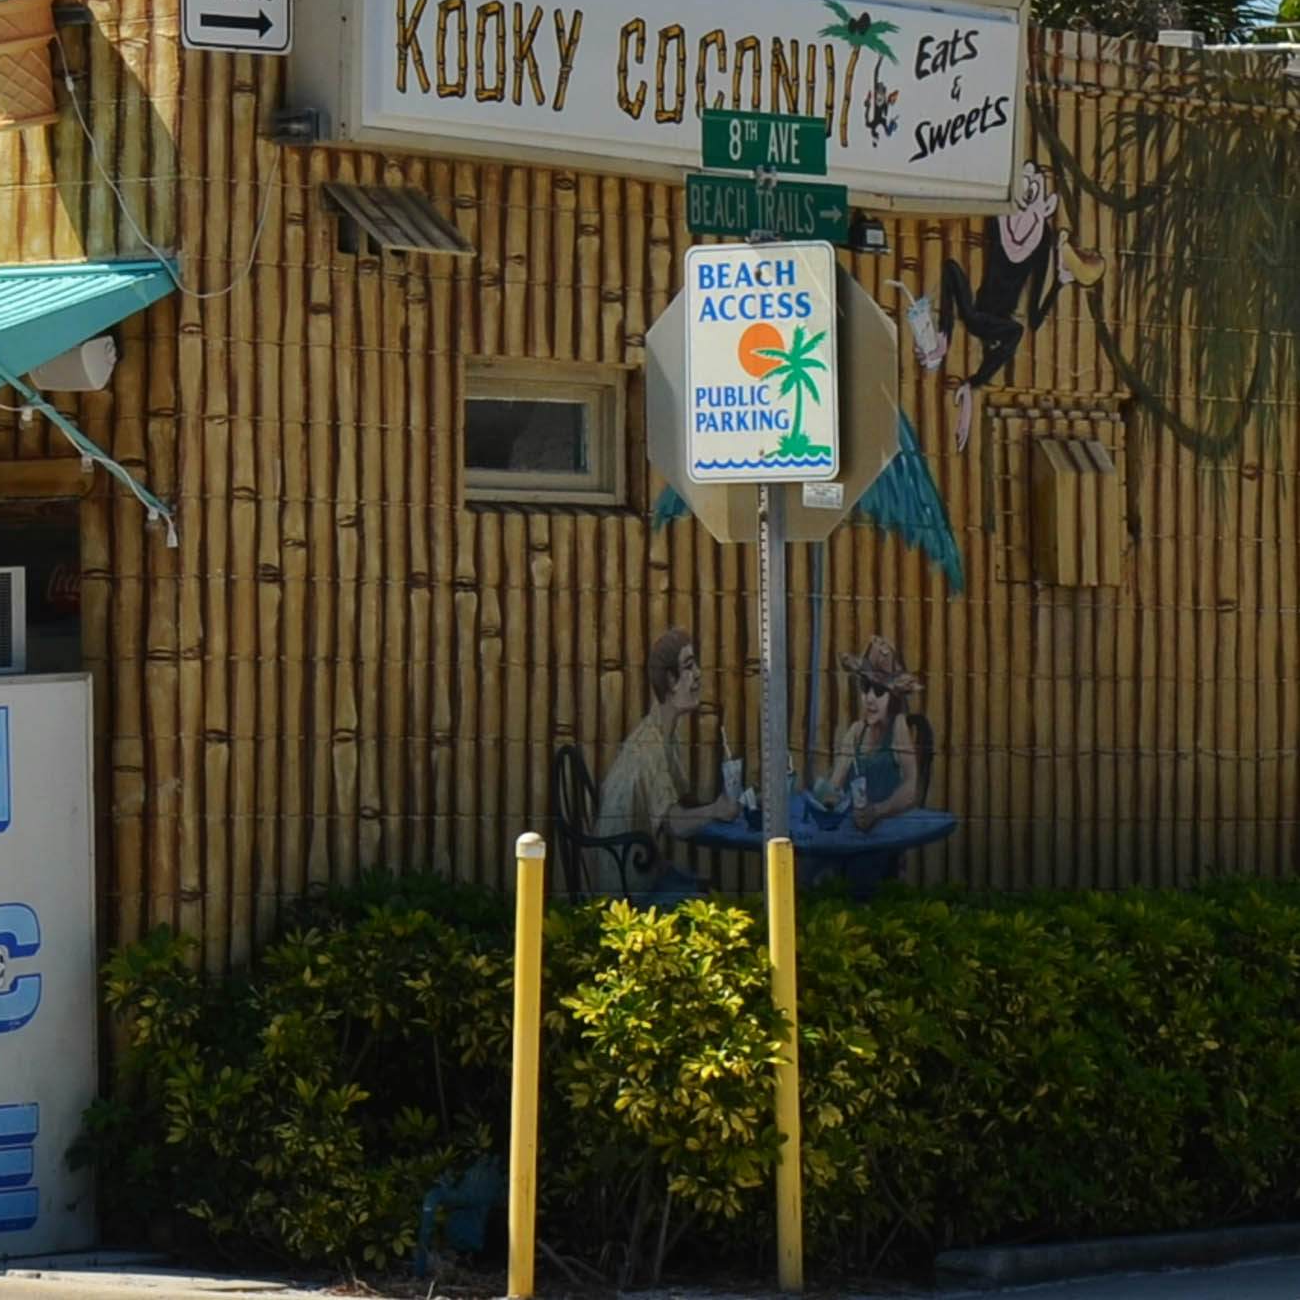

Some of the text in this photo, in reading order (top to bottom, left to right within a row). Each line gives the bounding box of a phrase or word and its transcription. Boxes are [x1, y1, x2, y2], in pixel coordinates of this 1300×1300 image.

[914, 28, 980, 80] Eats
[950, 75, 963, 102] &
[728, 118, 801, 165] 8TH AVE
[908, 95, 1010, 163] Sweets
[689, 183, 816, 235] BEACH TRAILS
[698, 260, 796, 290] BEACH
[698, 291, 813, 323] ACCESS
[695, 384, 771, 408] PUBLIC
[695, 408, 791, 433] PARKING
